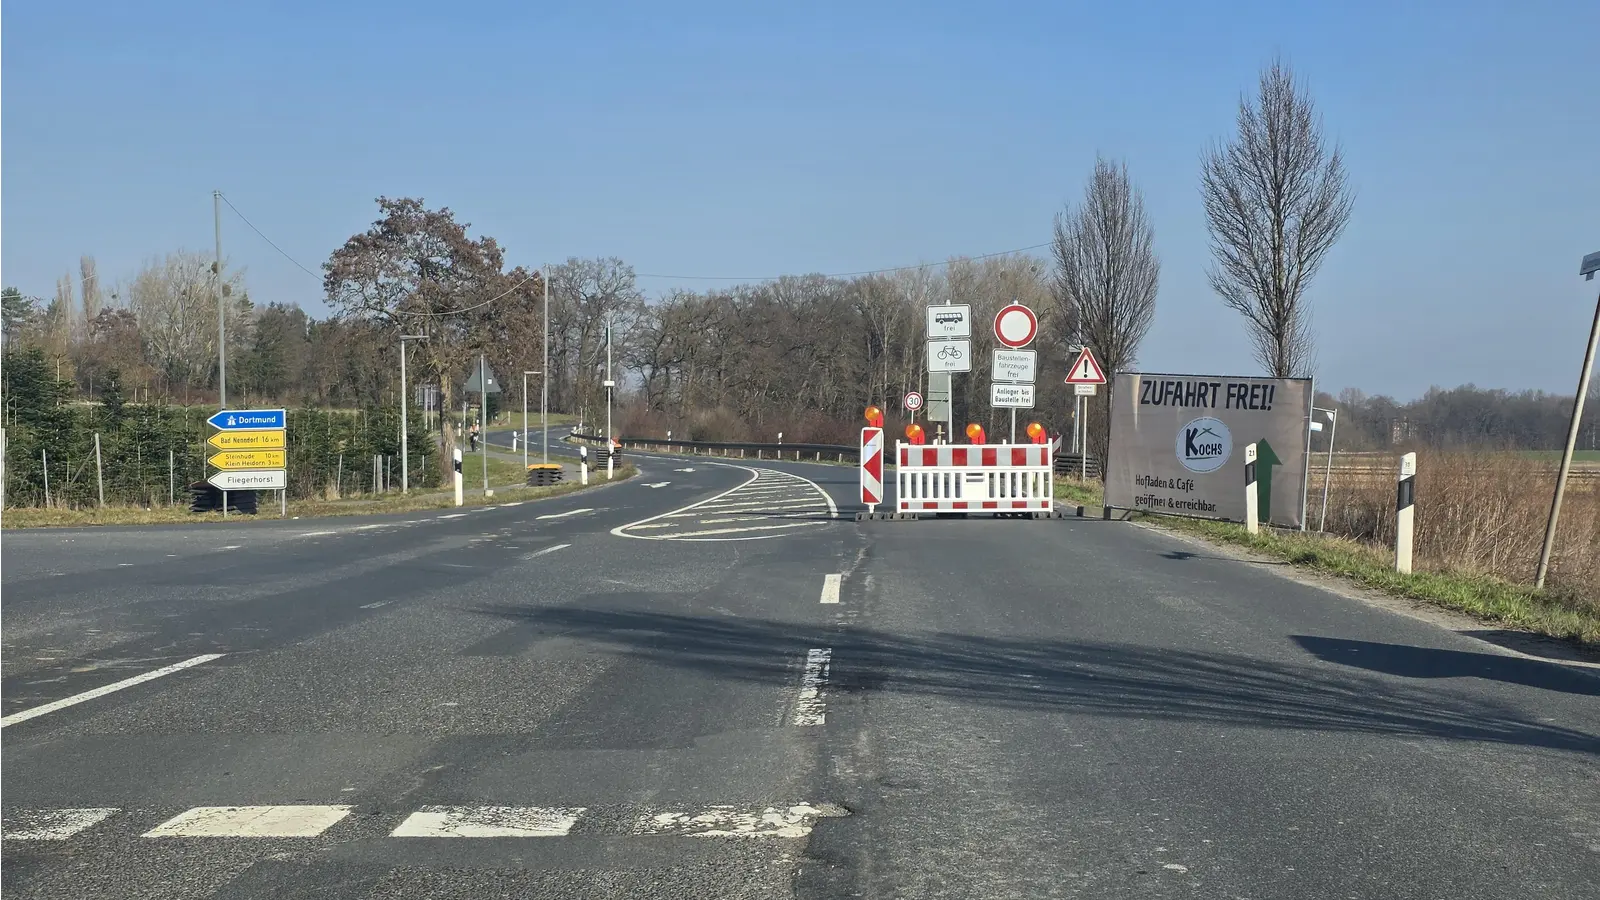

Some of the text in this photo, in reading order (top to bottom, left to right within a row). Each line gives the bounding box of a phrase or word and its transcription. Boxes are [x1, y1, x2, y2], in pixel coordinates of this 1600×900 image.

[999, 362, 1028, 370] fahrzeuge
[909, 397, 919, 405] 30
[1140, 380, 1275, 411] ZUFAHRT FREI!
[1136, 474, 1194, 493] Hofladen & Café
[1135, 494, 1216, 512] geöffnet & erreichbar.
